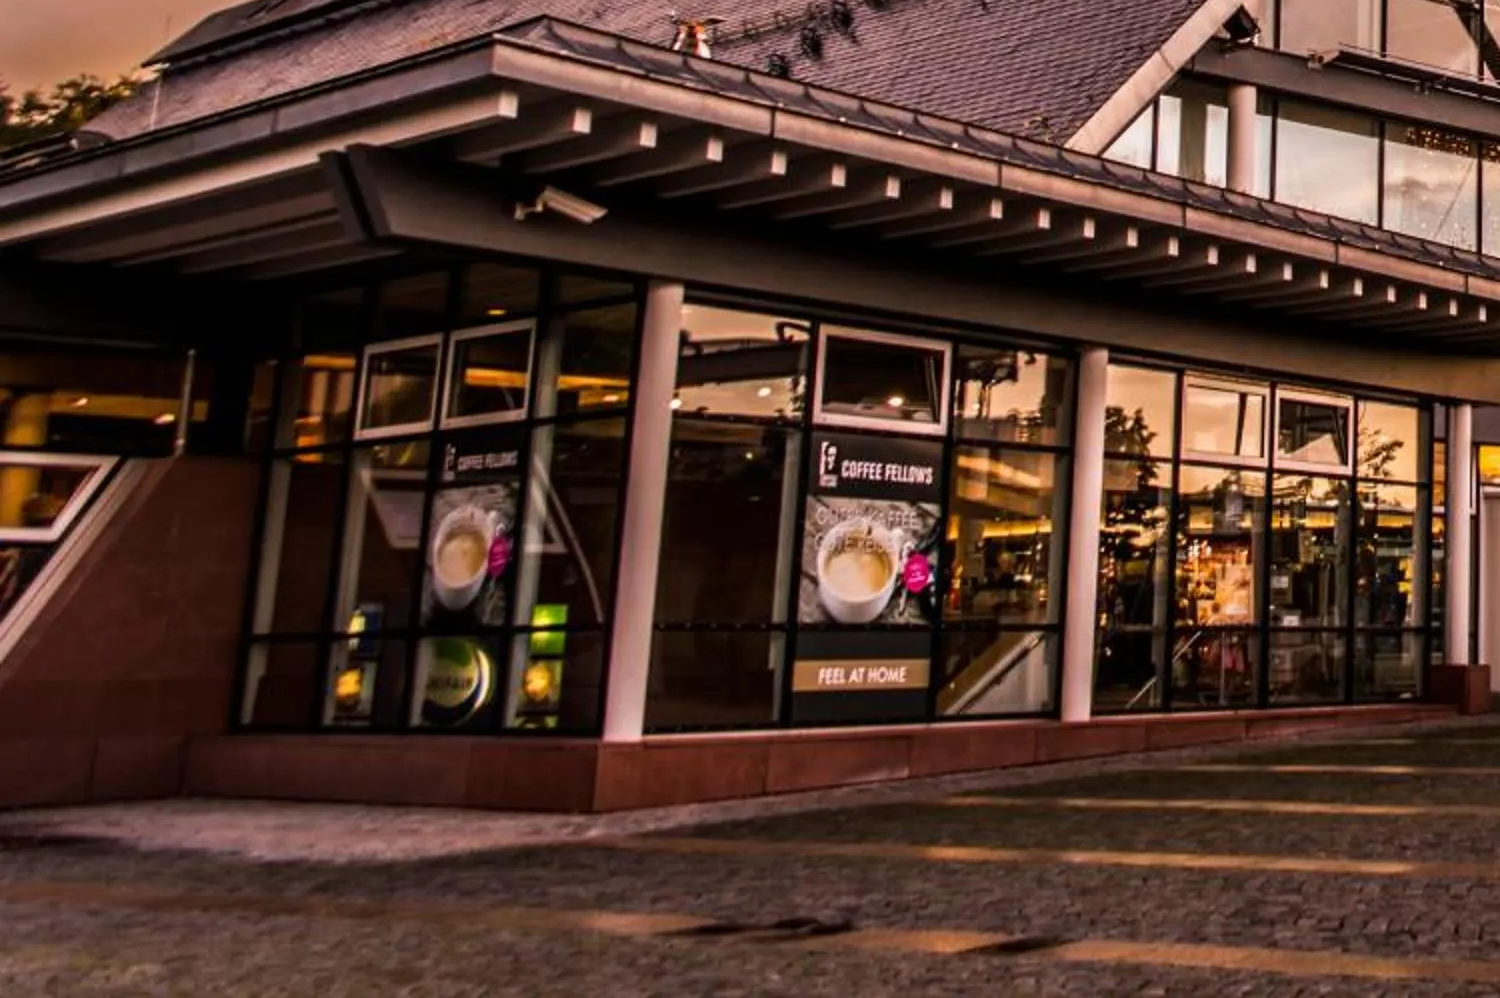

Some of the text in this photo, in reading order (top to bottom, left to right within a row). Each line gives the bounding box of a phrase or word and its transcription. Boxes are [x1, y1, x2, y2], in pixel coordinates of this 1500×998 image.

[841, 459, 883, 481] COFFEE
[884, 462, 934, 485] FELLOWS
[818, 665, 908, 685] FEEL AT HOME
